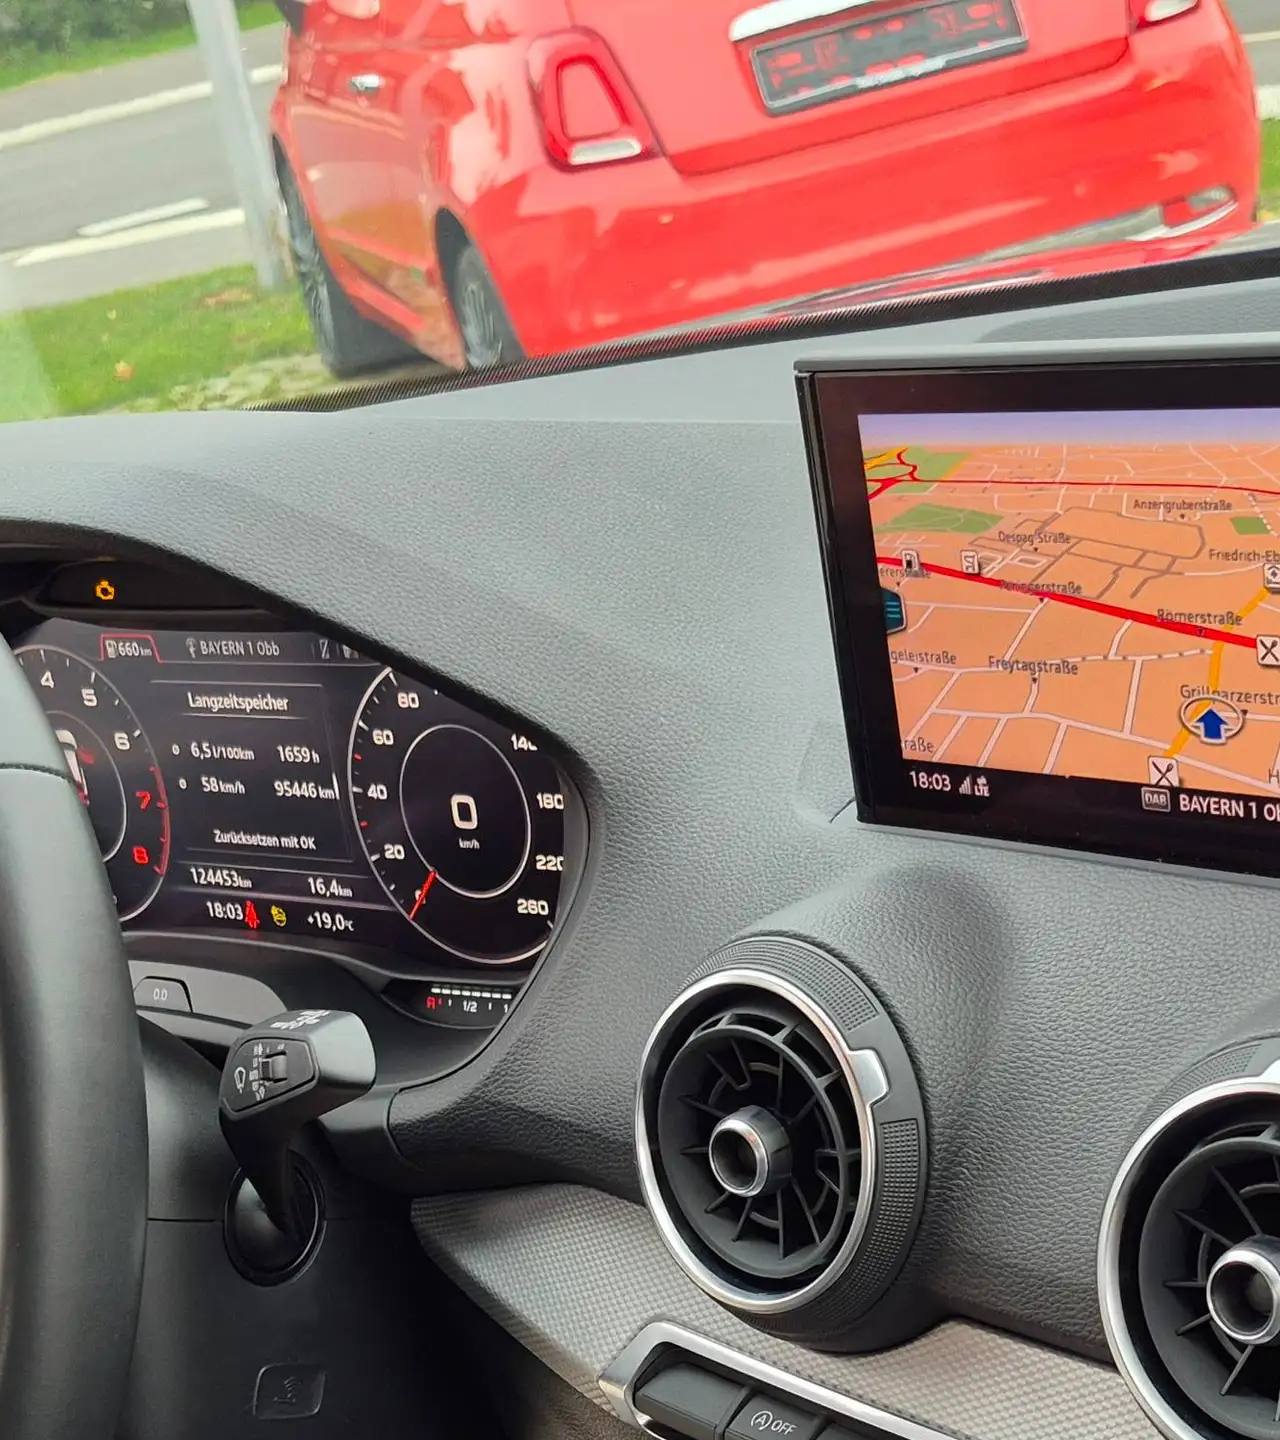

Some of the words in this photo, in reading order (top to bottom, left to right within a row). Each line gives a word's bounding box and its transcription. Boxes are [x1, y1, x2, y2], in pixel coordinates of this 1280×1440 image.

[200, 640, 244, 656] BAYERN
[248, 641, 254, 655] 1
[257, 640, 280, 656] Obb
[988, 656, 1079, 676] Freytagstraße
[41, 669, 54, 689] 4
[81, 688, 98, 707] 5
[187, 691, 289, 713] Langzeitspeicher
[397, 691, 420, 709] 80
[114, 731, 130, 750] 6
[373, 729, 394, 746] 60
[277, 745, 310, 763] 1659
[274, 780, 317, 798] 95446
[909, 770, 951, 792] 18:03
[136, 791, 151, 809] 7
[367, 783, 388, 800] 40
[536, 792, 564, 810] 180
[1144, 792, 1167, 807] DAB
[1179, 793, 1245, 818] BAYERN
[1248, 802, 1258, 820] 1
[450, 793, 479, 830] 0
[213, 829, 280, 847] Zurücksetzen
[281, 835, 300, 849] mit
[300, 836, 317, 850] OK
[459, 837, 480, 849] km/h
[133, 846, 149, 864] 8
[384, 843, 405, 860] 20
[206, 900, 243, 921] 18:03
[517, 898, 549, 916] 260
[463, 1000, 478, 1013] 1/2
[770, 1419, 797, 1435] OFF
